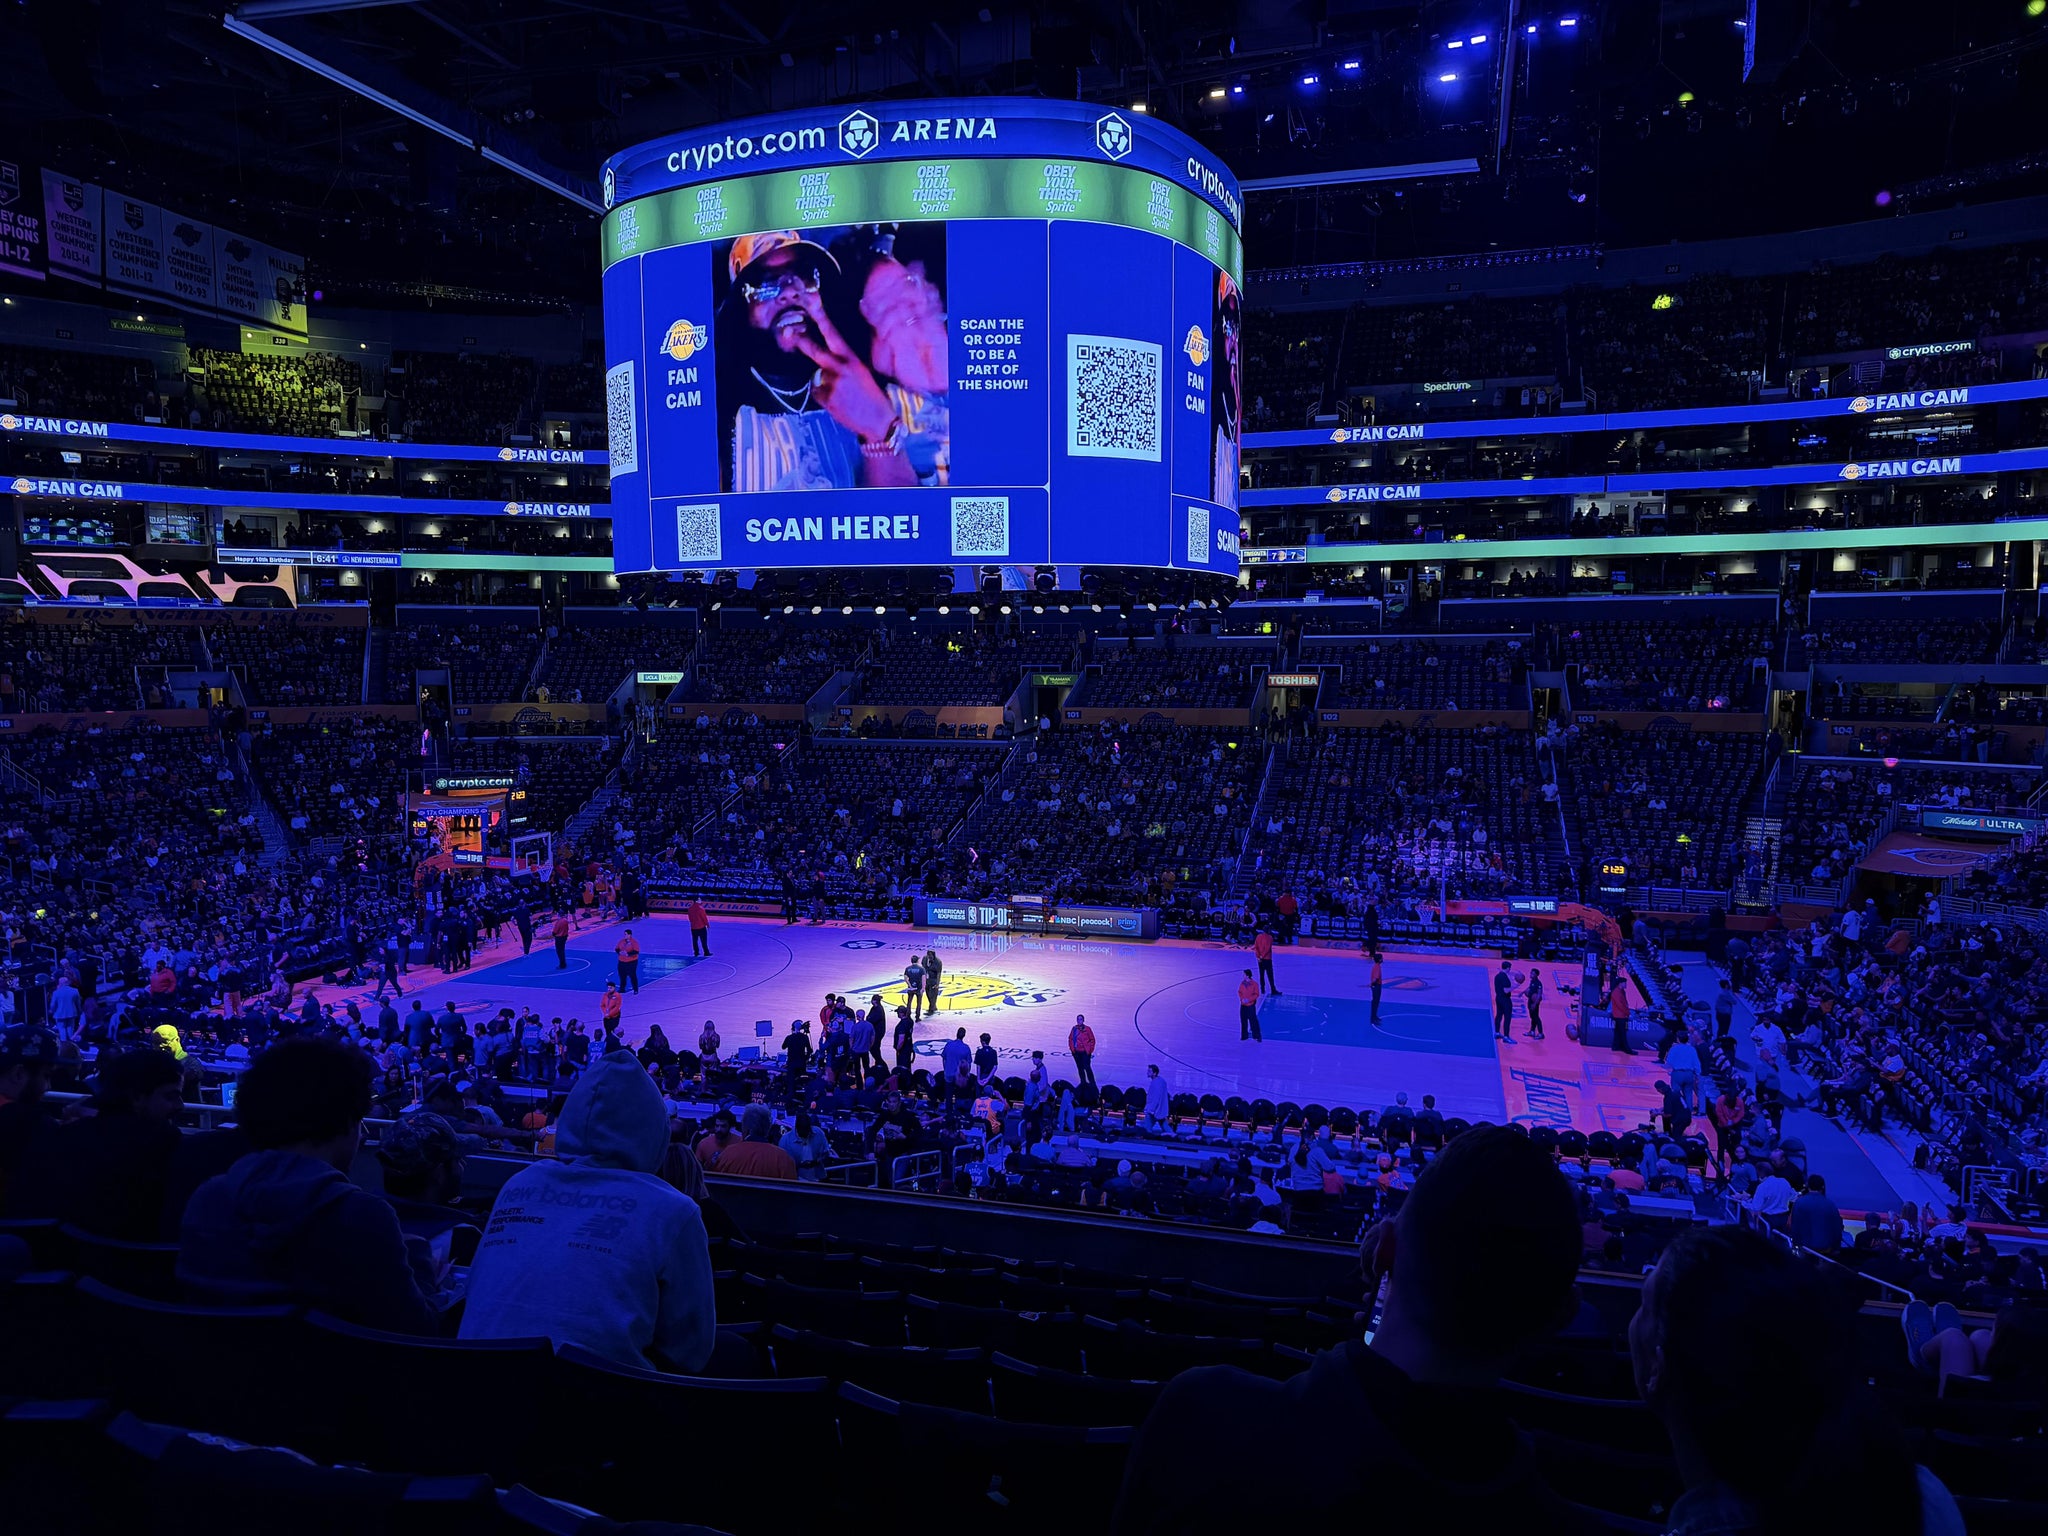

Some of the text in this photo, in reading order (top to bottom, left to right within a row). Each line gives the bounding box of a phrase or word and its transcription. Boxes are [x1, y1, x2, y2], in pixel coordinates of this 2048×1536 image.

[891, 118, 997, 142] ARENA
[667, 126, 825, 172] crypto.com
[917, 165, 950, 178] OBEY
[1043, 164, 1077, 178] OBEY
[799, 172, 830, 186] OBEY
[918, 177, 950, 189] YOUR
[1045, 176, 1075, 189] YOUR
[696, 186, 723, 201] OBEY
[800, 184, 829, 197] YOUR
[1150, 180, 1171, 197] OBEY
[698, 198, 723, 211] YOUR
[1151, 191, 1170, 208] YOUR
[919, 201, 950, 214] Sprite
[1045, 201, 1075, 214] Sprite
[17, 214, 39, 230] CUP
[55, 209, 92, 229] WESTERN
[801, 209, 829, 222] Sprite
[1151, 215, 1170, 231] Sprite
[50, 220, 97, 242] CONFERENCE
[699, 222, 723, 236] Sprite
[54, 231, 96, 253] CHAMPIONS
[115, 229, 154, 248] WESTERN
[60, 247, 90, 266] 2013-14
[109, 238, 160, 260] CONFERENCE
[112, 250, 159, 270] CHAMPIONS
[167, 255, 212, 277] CONFERENCE
[119, 265, 153, 282] 2011-12
[169, 266, 210, 285] CHAMPIONS
[174, 279, 207, 298] 1992-93
[960, 319, 1024, 330] SCAN THE
[661, 331, 707, 352] LAKERS
[963, 334, 1022, 346] QR CODE
[968, 349, 1017, 360] TO BE A
[1902, 342, 1971, 357] crypto.com
[668, 367, 698, 386] FAN
[966, 364, 1019, 375] PART OF
[957, 379, 1028, 390] THE SHOW!
[1187, 371, 1204, 392] FAN
[1423, 382, 1468, 393] Spectrum
[665, 390, 702, 409] CAM
[1185, 393, 1205, 415] CAM
[1876, 388, 1969, 410] FAN CAM
[24, 417, 109, 436] FAN CAM
[1352, 427, 1384, 440] FAN
[1386, 425, 1424, 439] CAM
[519, 449, 548, 461] FAN
[550, 450, 584, 463] CAM
[1867, 457, 1962, 477] FAN CAM
[38, 480, 123, 498] FAN CAM
[1348, 487, 1380, 500] FAN
[1383, 485, 1421, 499] CAM
[524, 503, 554, 516] FAN
[556, 505, 591, 516] CAM
[745, 515, 920, 542] SCAN HERE!
[1217, 528, 1235, 554] SCAN
[316, 553, 336, 563] 6:41
[350, 556, 362, 564] NEW
[362, 556, 394, 564] AMSTERDAM
[1271, 552, 1277, 560] 7
[1291, 552, 1297, 560] 7
[1269, 676, 1318, 685] TOSHIBA
[1578, 715, 1594, 723] 103
[1833, 726, 1853, 735] 104
[448, 777, 513, 788] crypto.com
[1986, 819, 2025, 830] ULTRA
[1060, 916, 1077, 924] NBC
[1080, 918, 1110, 926] peacock
[1117, 918, 1137, 926] prime
[501, 1182, 637, 1214] new balance
